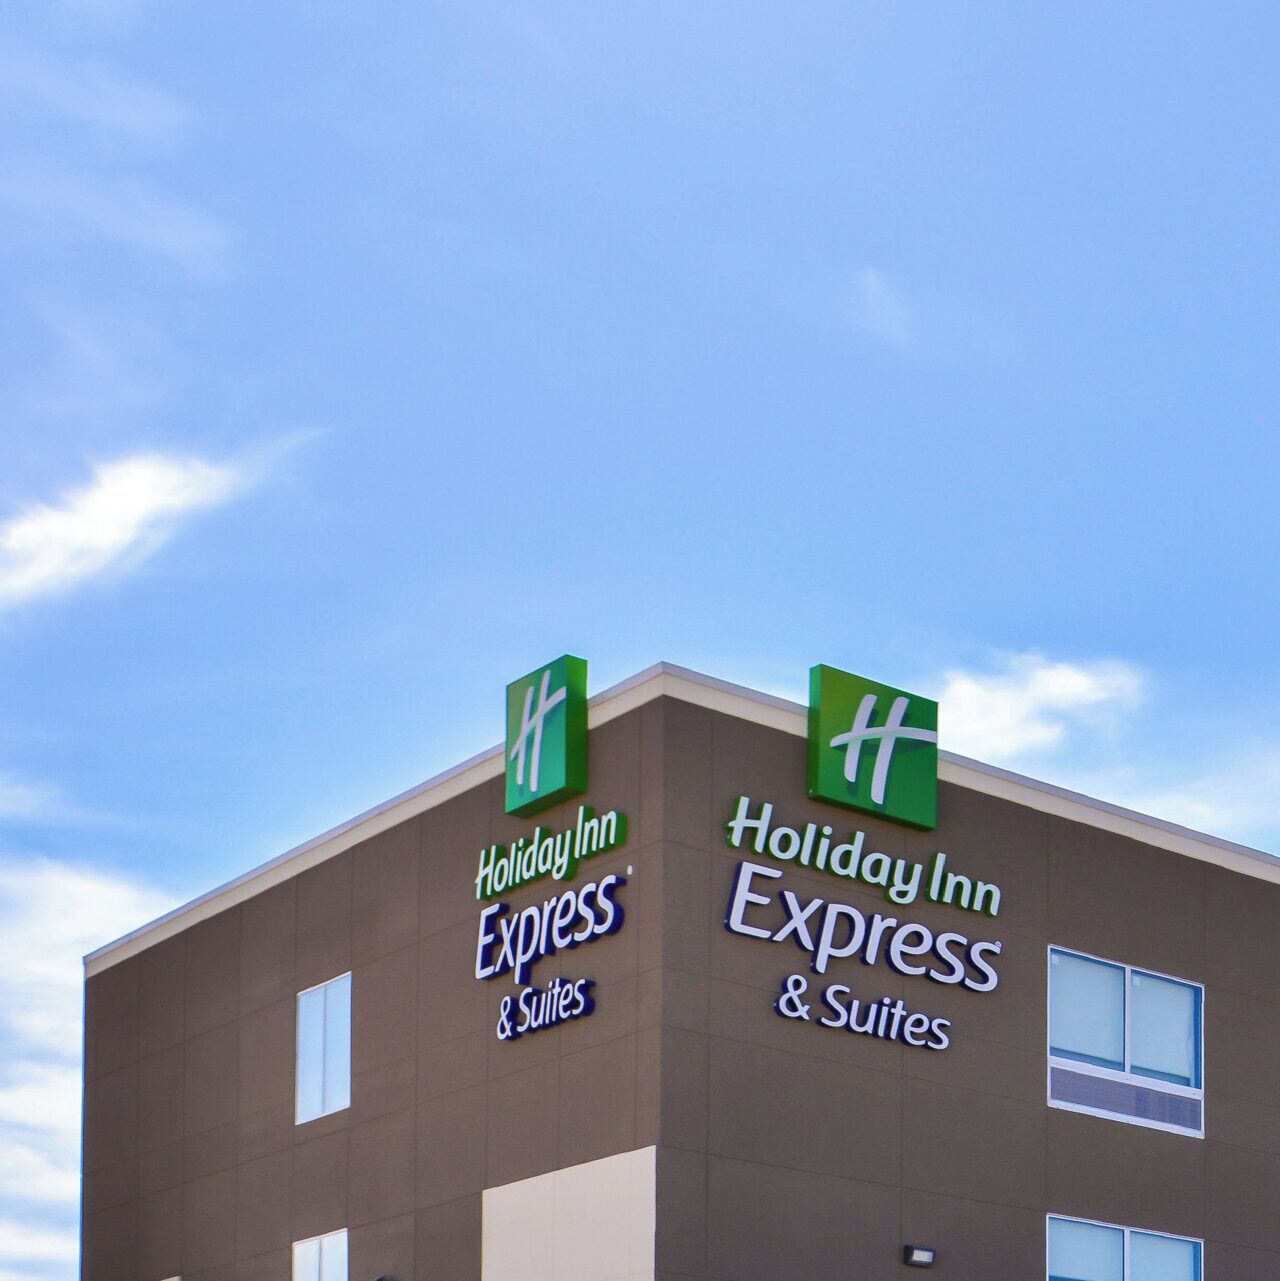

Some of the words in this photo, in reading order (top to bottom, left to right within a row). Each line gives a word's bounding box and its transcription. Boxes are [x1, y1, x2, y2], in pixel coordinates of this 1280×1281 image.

[475, 828, 572, 901] Holiday
[573, 806, 618, 860] Inn
[727, 796, 923, 904] Holiday
[929, 853, 1001, 916] Inn
[475, 874, 617, 984] Express
[727, 862, 1000, 992] Express
[496, 997, 513, 1040] &
[516, 979, 586, 1031] Suites
[778, 974, 810, 1021] &
[819, 984, 952, 1049] Suites
